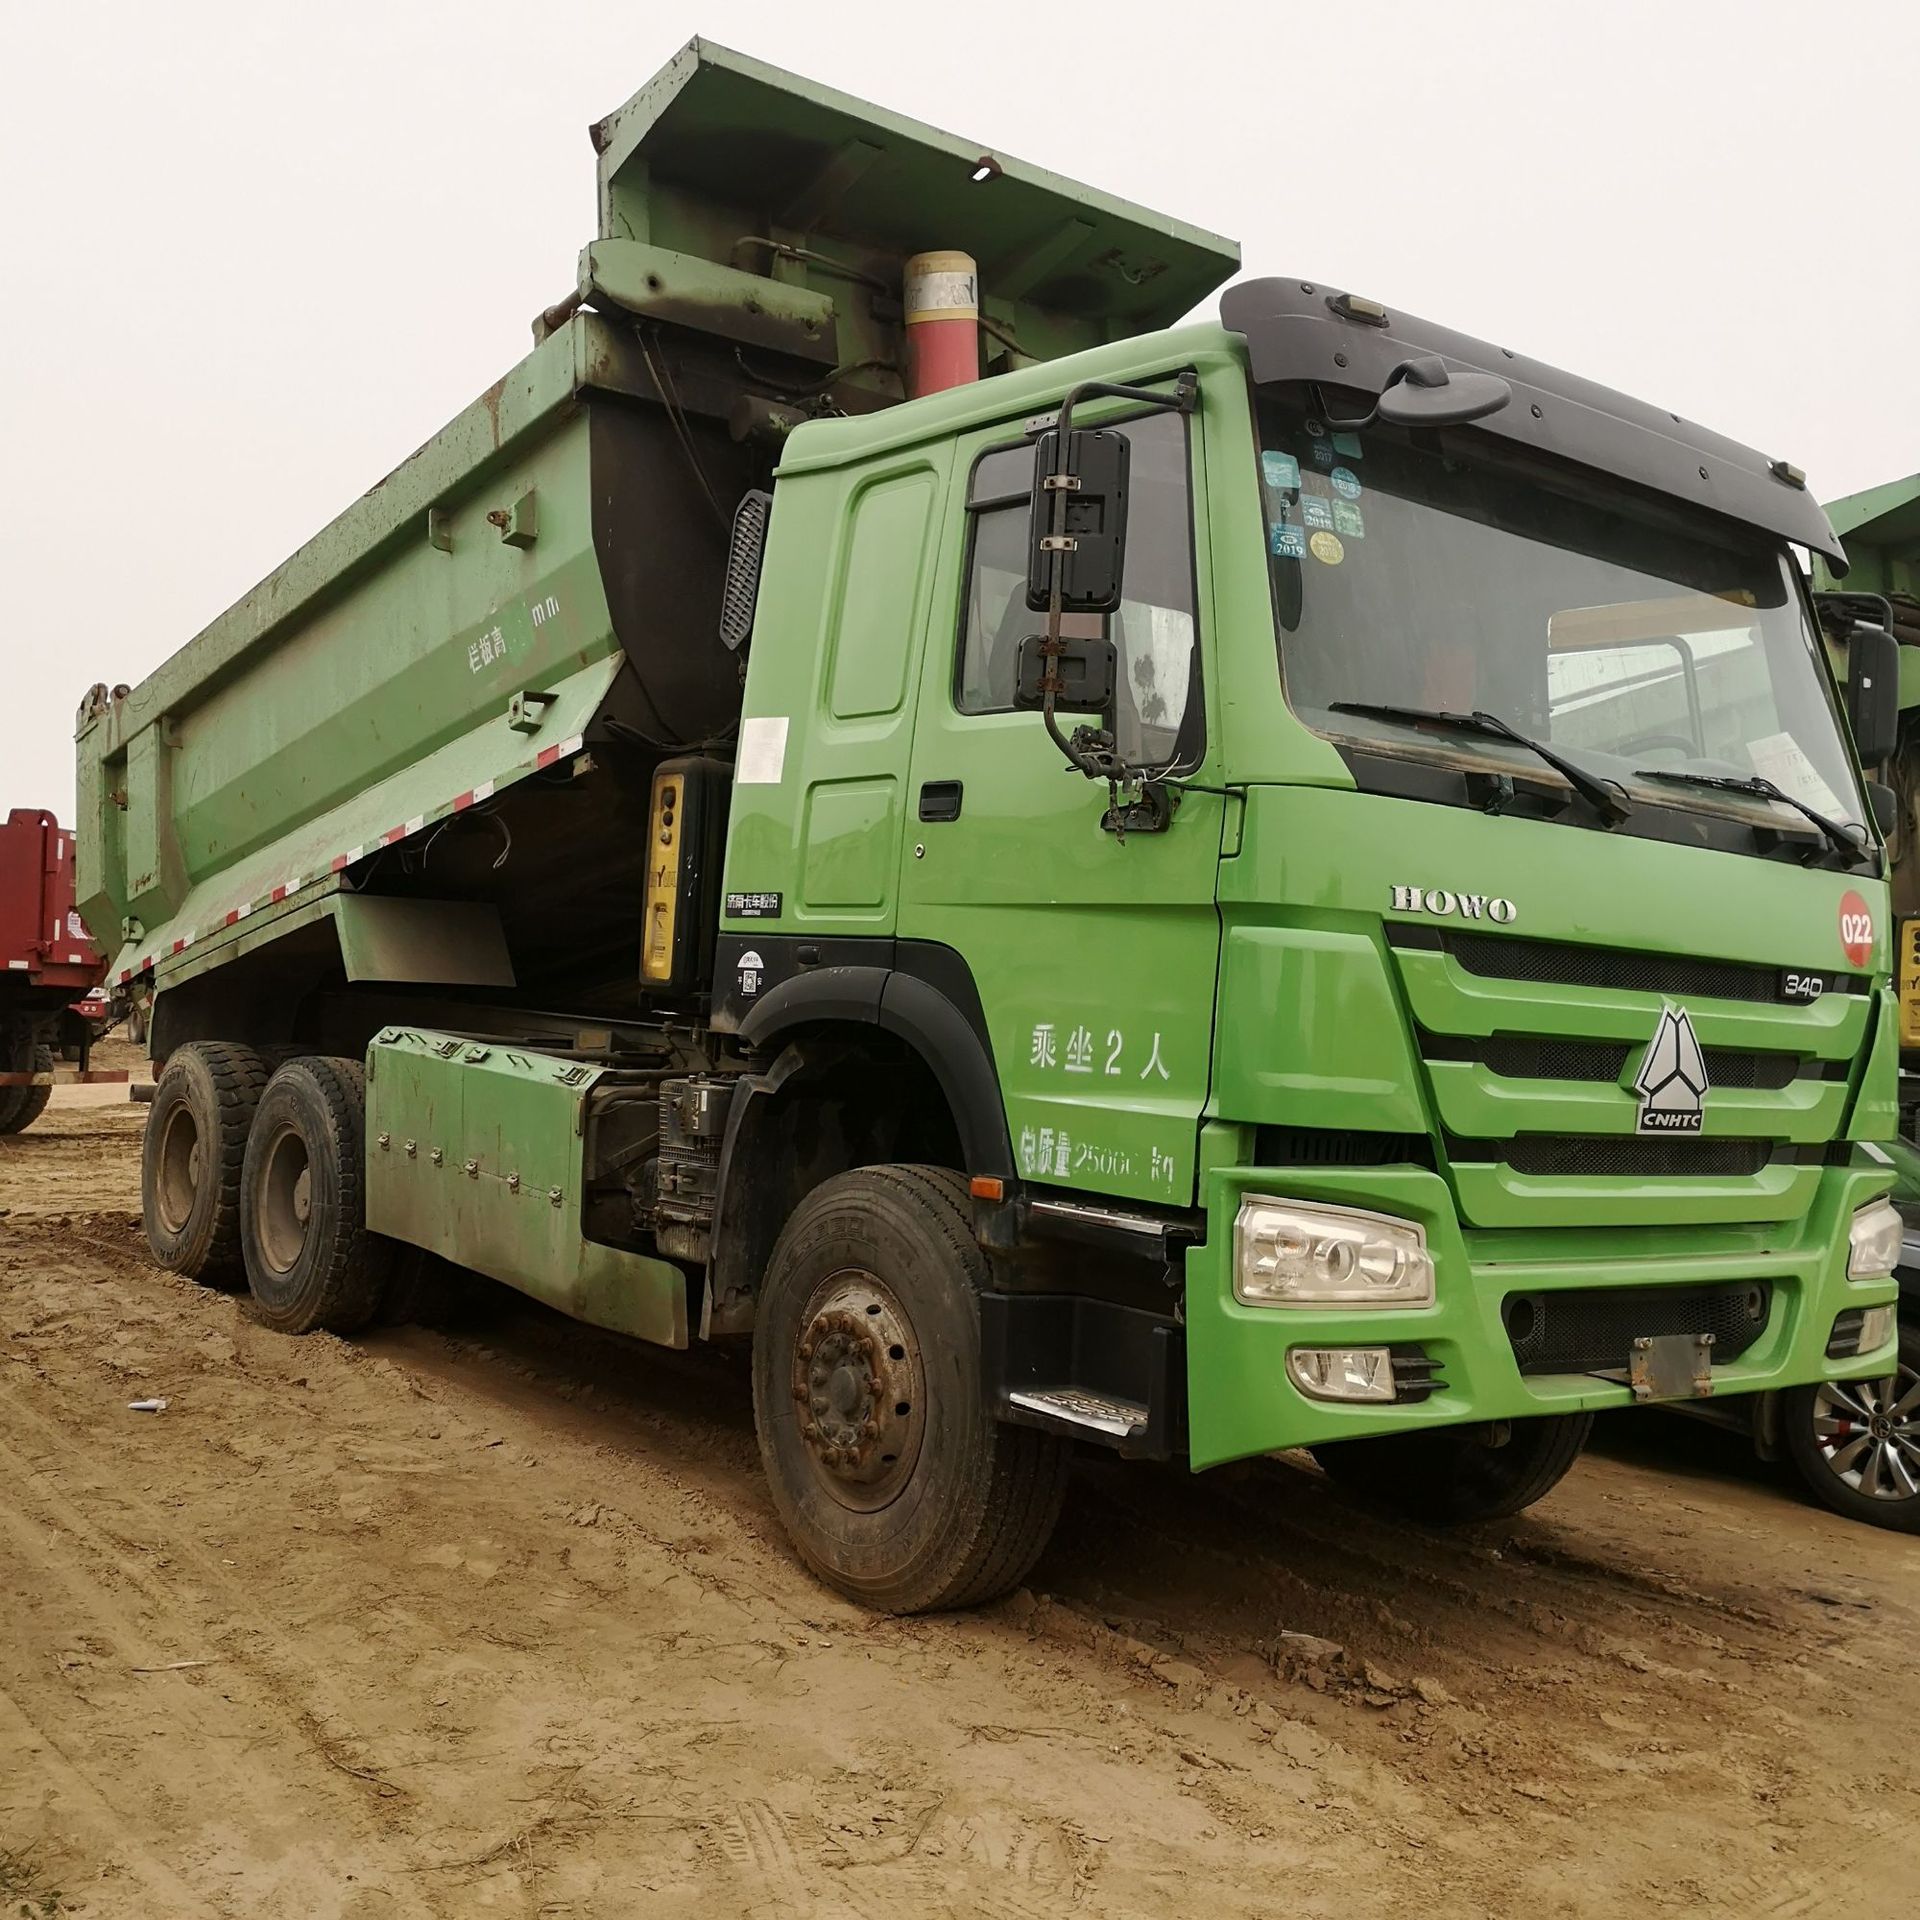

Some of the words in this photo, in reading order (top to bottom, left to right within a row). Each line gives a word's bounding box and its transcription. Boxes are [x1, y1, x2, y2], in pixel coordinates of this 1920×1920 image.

[1276, 543, 1304, 556] 2019
[1389, 884, 1517, 924] HOWO
[1842, 914, 1873, 943] 022
[1785, 974, 1823, 997] 340
[1643, 1112, 1701, 1127] CNHTC
